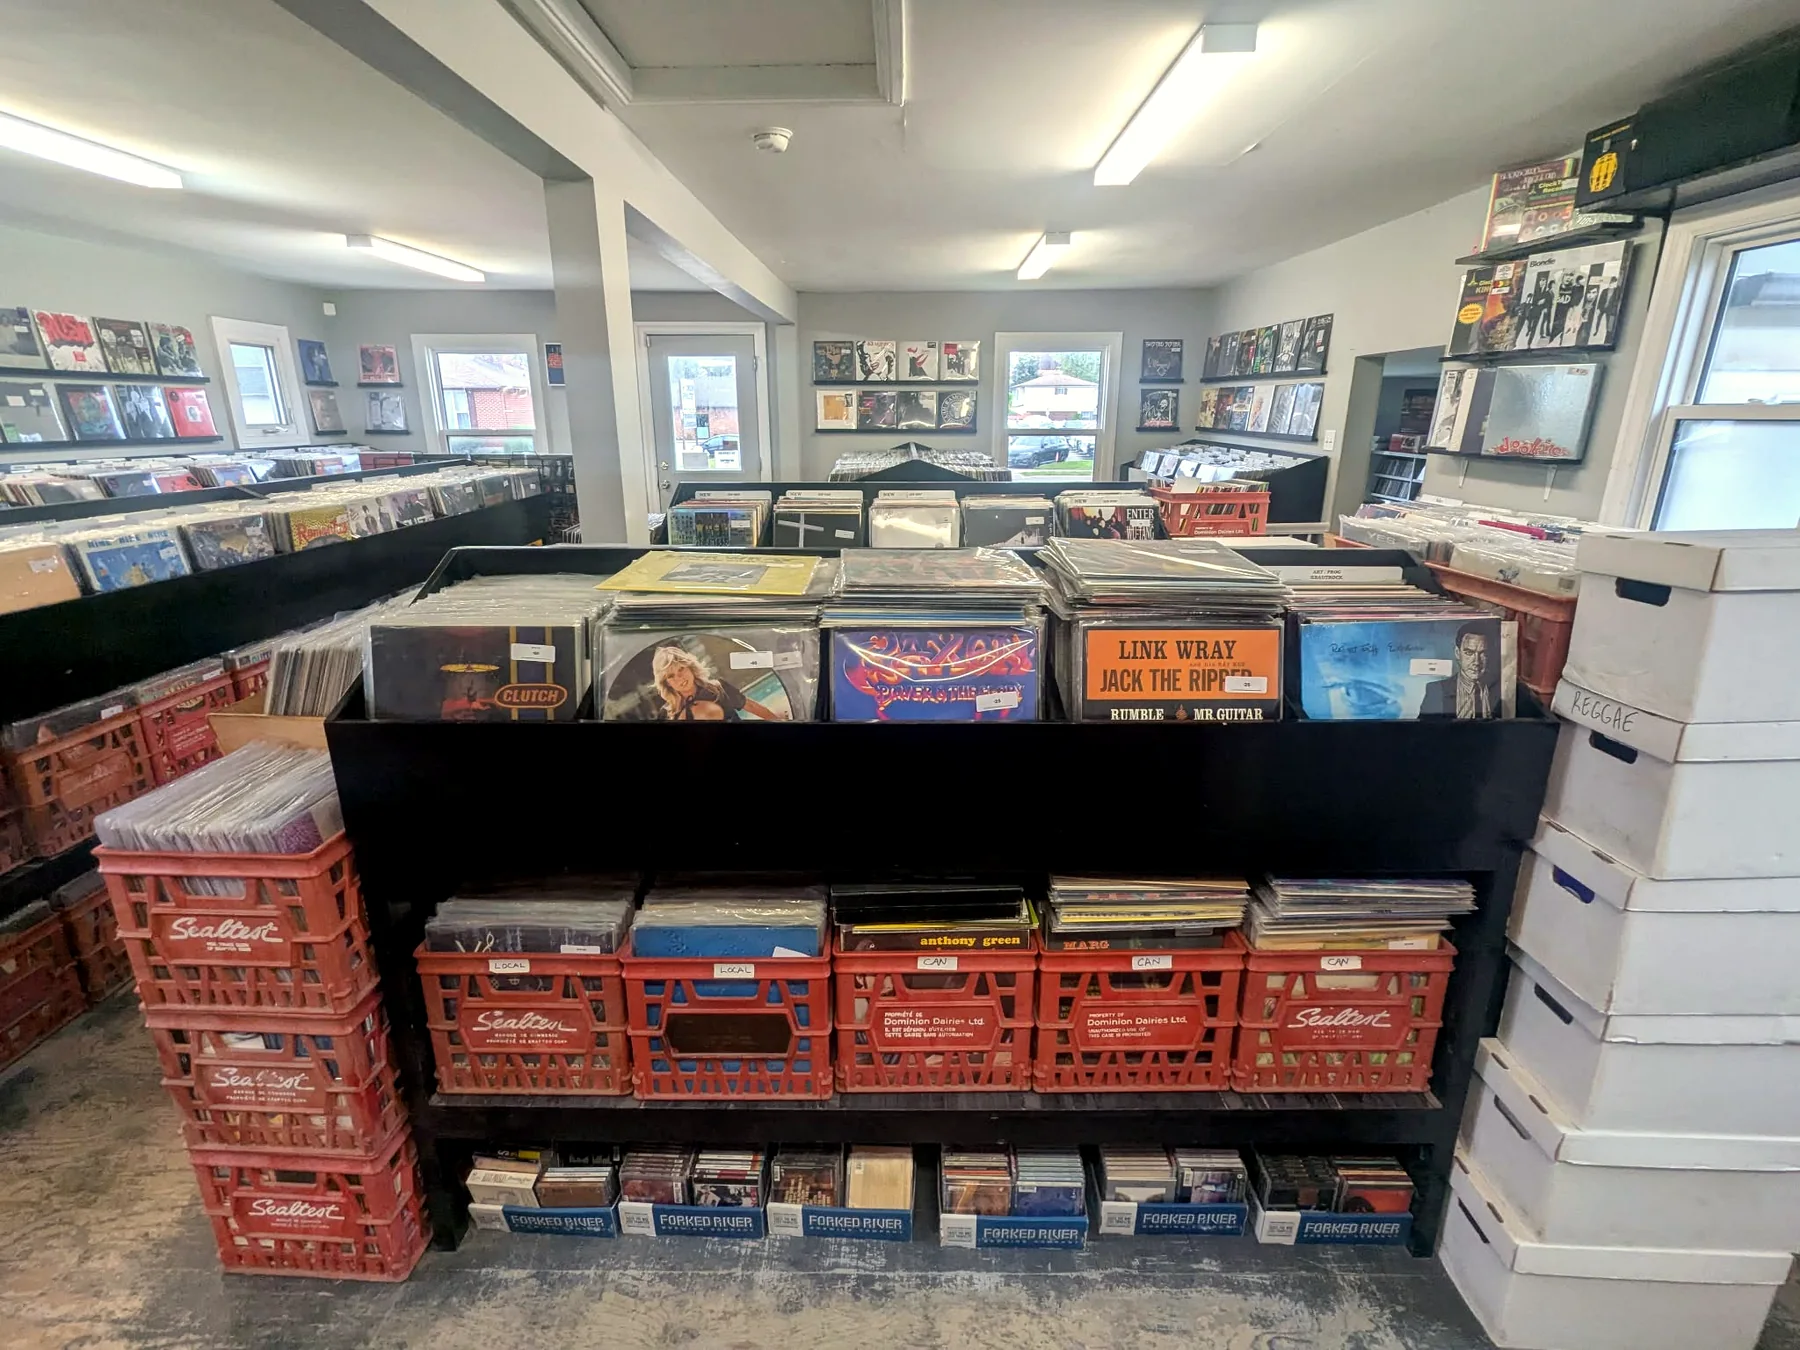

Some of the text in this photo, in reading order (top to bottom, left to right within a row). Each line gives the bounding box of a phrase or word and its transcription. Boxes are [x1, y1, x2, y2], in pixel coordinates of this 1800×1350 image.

[1529, 258, 1556, 268] Blondie
[1127, 508, 1154, 520] ENTER
[1118, 640, 1237, 660] LINK WRAY
[1100, 669, 1143, 693] JACK
[1149, 668, 1182, 692] THE
[503, 689, 559, 702] CLUTCH
[1110, 708, 1164, 721] RUMBLE
[1571, 691, 1639, 732] REGGAE
[169, 917, 283, 943] Sealtest
[920, 936, 1021, 947] anthony green
[494, 962, 525, 970] LOCAL
[923, 957, 947, 966] CAN
[1137, 957, 1160, 967] CAN
[1327, 958, 1349, 967] CAN
[720, 966, 752, 974] LOCAL
[968, 1017, 985, 1025] Ltd.
[1087, 1016, 1188, 1026] Dominion Dairies Ltd.
[1287, 1007, 1392, 1028] Sealtest
[248, 1199, 345, 1220] Sealtest
[510, 1215, 561, 1227] FORKED
[564, 1217, 604, 1227] RIVER
[660, 1214, 711, 1227] FORKED
[713, 1216, 752, 1228] RIVER
[809, 1215, 860, 1228] FORKED
[863, 1218, 902, 1229] RIVER
[1143, 1213, 1194, 1224] FORKED
[1198, 1213, 1237, 1225] RIVER
[983, 1228, 1036, 1239] FORKED
[1038, 1229, 1078, 1240] RIVER
[1304, 1222, 1358, 1233] FORKED
[1360, 1223, 1400, 1234] RIVER
